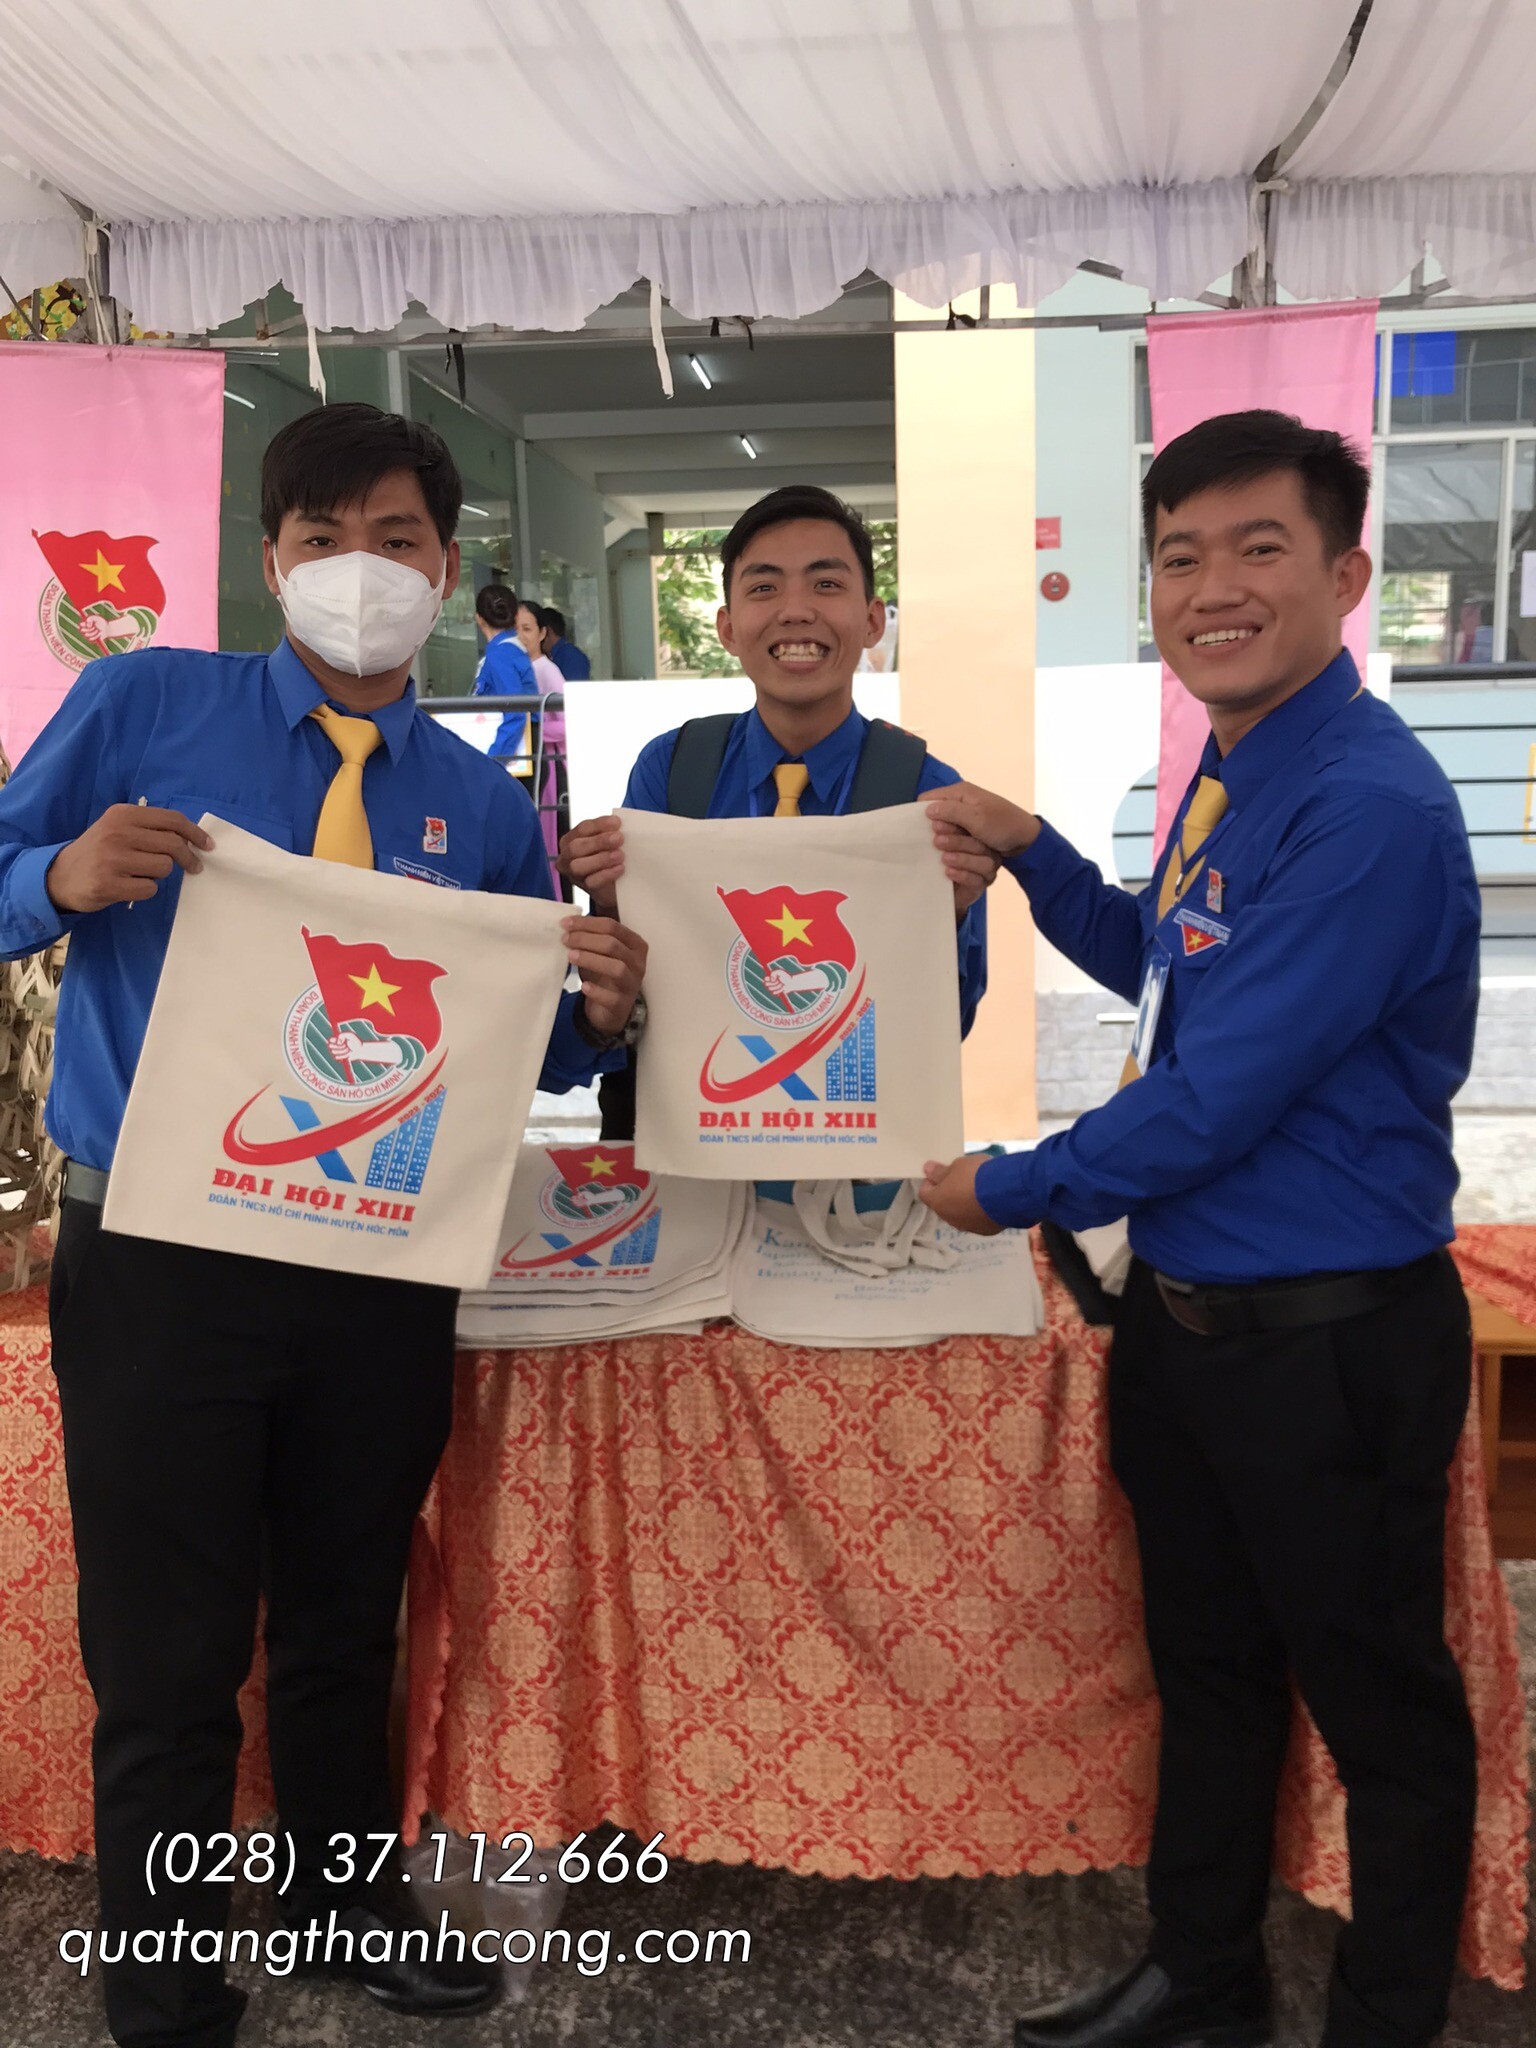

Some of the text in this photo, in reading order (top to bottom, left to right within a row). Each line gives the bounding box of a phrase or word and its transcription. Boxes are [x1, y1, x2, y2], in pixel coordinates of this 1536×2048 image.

[289, 1014, 303, 1048] THANH
[380, 1070, 404, 1091] MINH
[699, 1107, 877, 1132] ĐẠI HỘI XIII
[726, 1134, 749, 1144] TNCS
[782, 1134, 804, 1144] MINH
[208, 1192, 238, 1206] ĐOÀN
[240, 1199, 267, 1213] TNCS
[285, 1207, 303, 1220] CHÍ
[304, 1213, 329, 1226] MINH
[330, 1217, 364, 1232] HUYỆN
[212, 1168, 416, 1222] ĐẠI HỘI XIII
